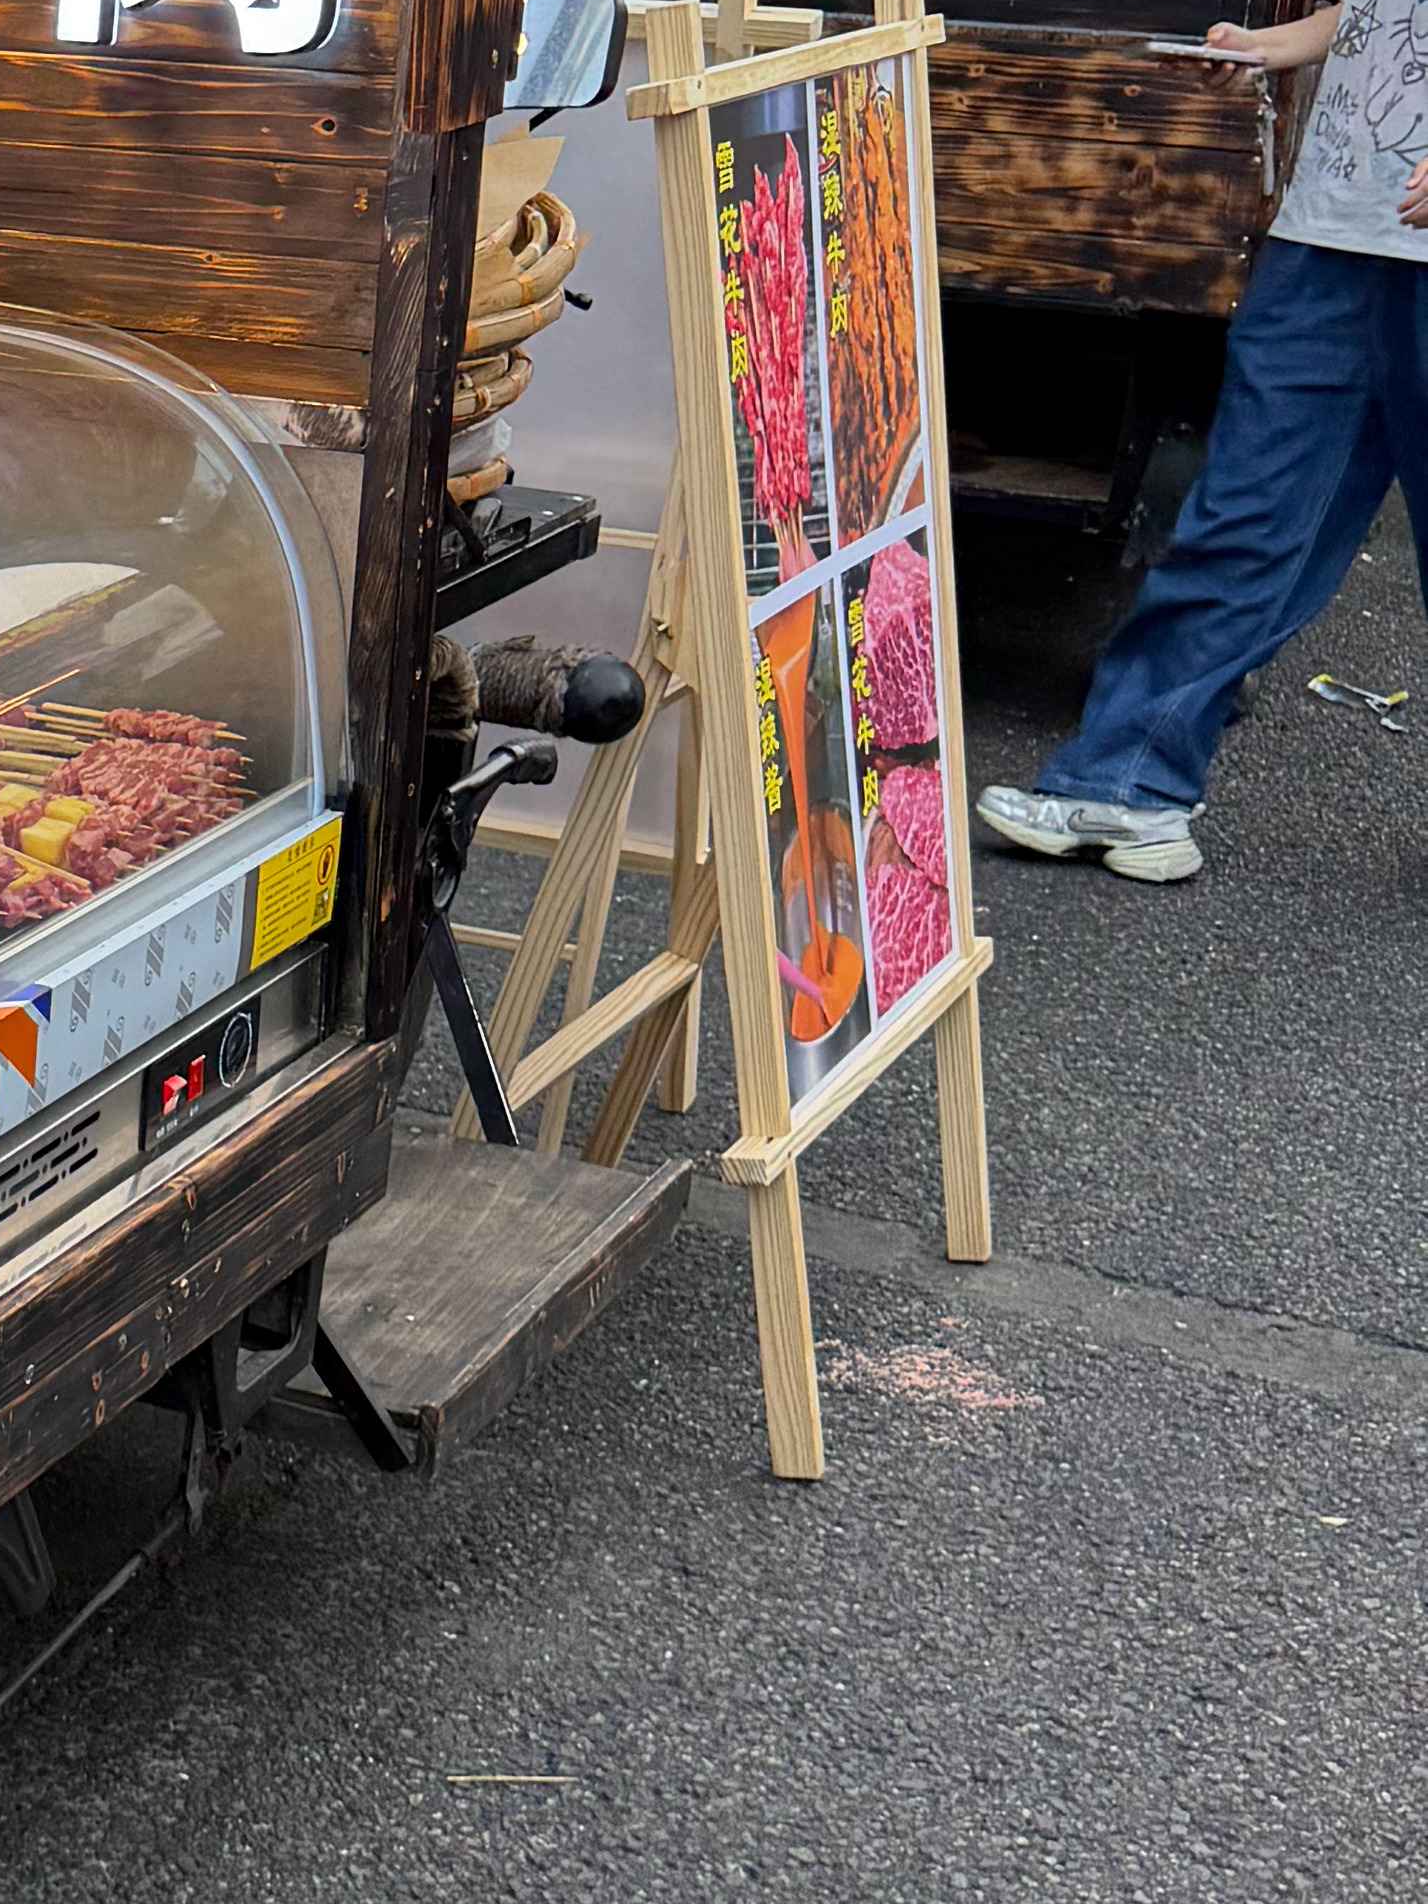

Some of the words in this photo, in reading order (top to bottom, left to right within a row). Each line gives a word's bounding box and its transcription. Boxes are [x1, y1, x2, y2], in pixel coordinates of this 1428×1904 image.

[715, 141, 749, 383] 雪花牛肉
[848, 597, 880, 816] 雪花牛肉
